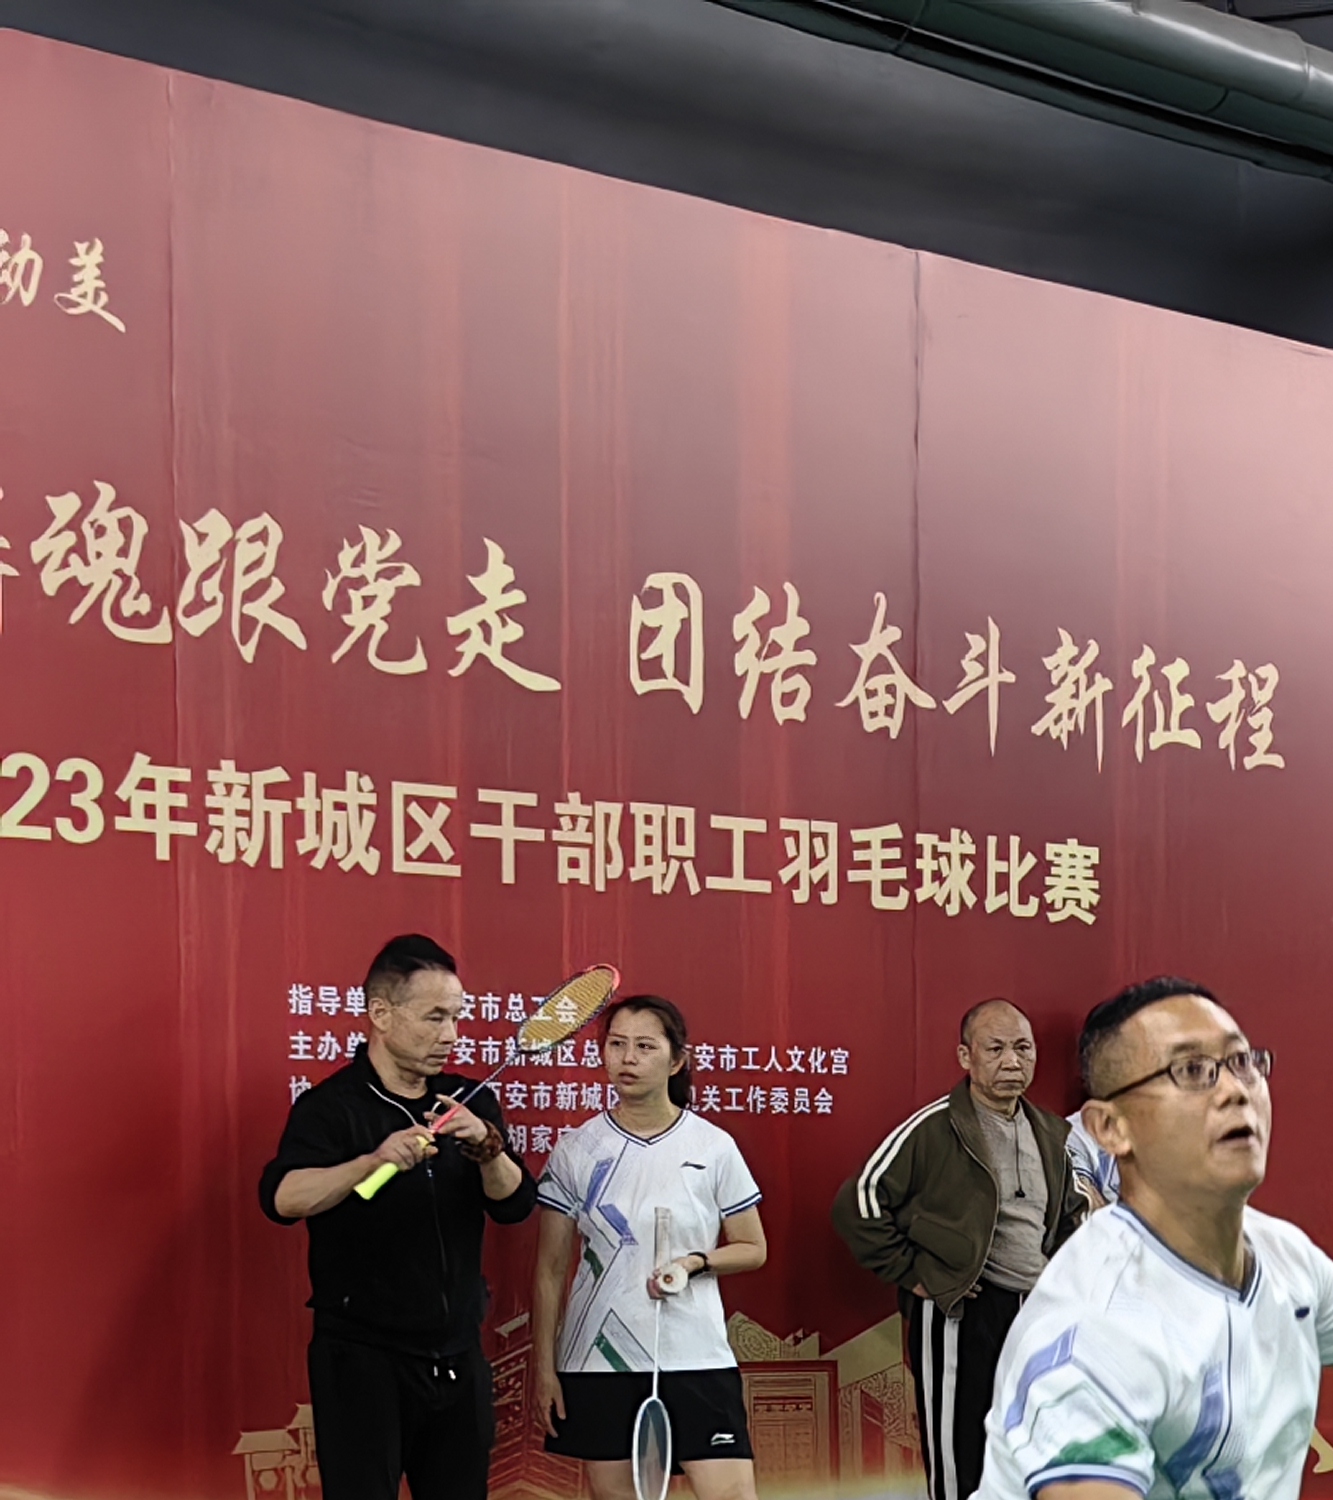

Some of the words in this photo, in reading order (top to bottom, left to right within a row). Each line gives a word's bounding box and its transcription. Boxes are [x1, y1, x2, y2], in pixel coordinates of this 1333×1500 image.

[0, 481, 561, 691] 魂跟党走
[630, 572, 1286, 773] 团结奋斗新征程
[0, 752, 1101, 924] 23年新城区干部职工羽毛球比赛
[684, 1043, 849, 1075] 安市工人文化宫
